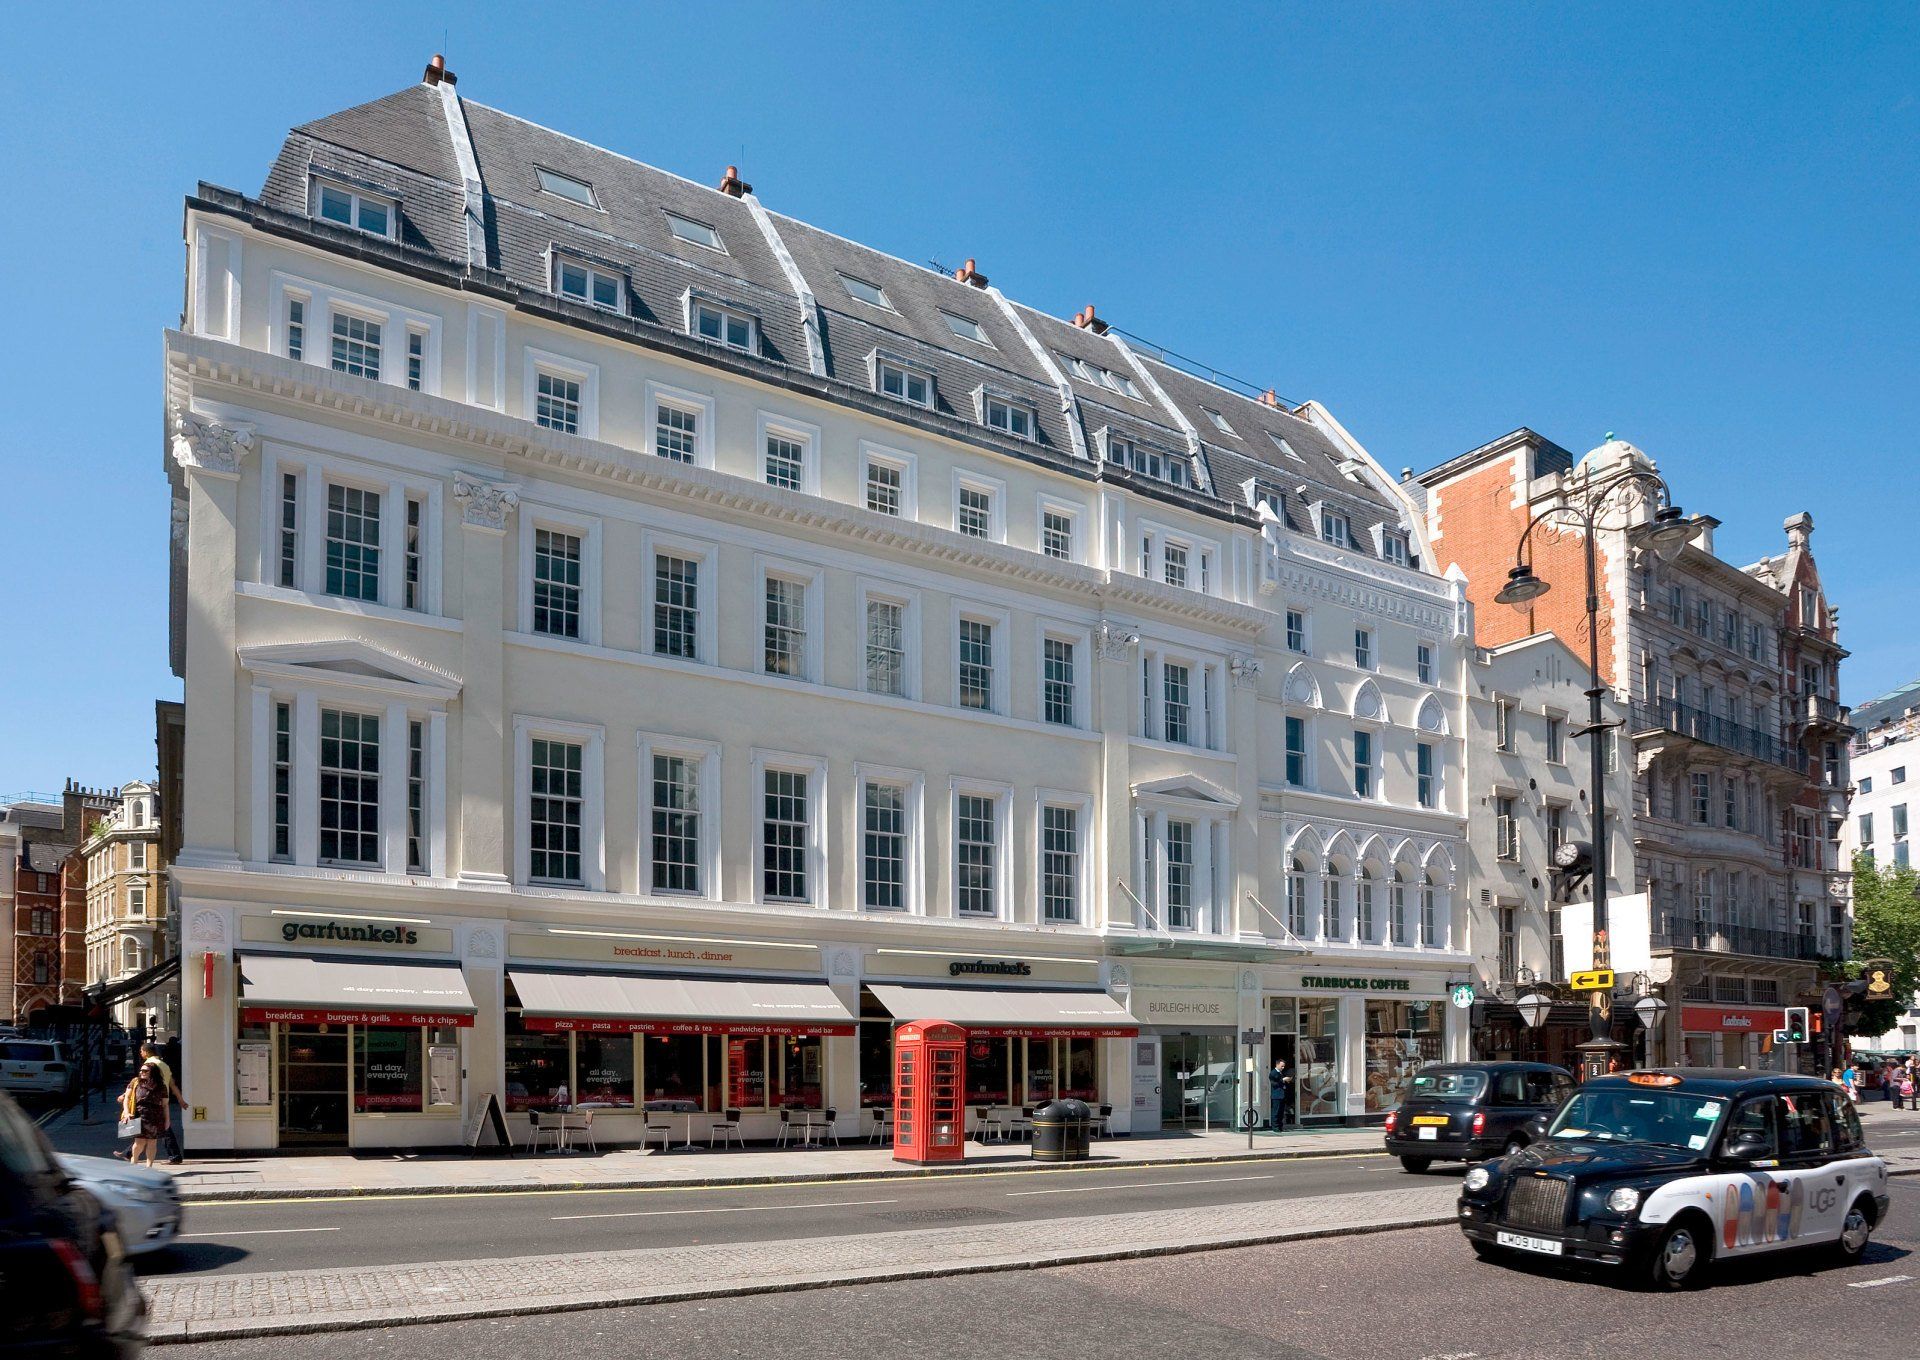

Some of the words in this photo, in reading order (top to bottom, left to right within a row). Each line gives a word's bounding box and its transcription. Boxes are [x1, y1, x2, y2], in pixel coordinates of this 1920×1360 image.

[282, 922, 417, 944] garfunkel's
[613, 946, 662, 958] breakfast
[667, 948, 695, 960] lunch
[701, 951, 732, 961] dinner
[950, 959, 1031, 976] garfunkel's
[1301, 976, 1368, 989] STARBUCKS
[1370, 979, 1409, 990] COFFEE
[1149, 1002, 1190, 1013] BURLEIGH
[1192, 1003, 1220, 1014] HOUSE
[265, 1012, 304, 1020] breakfast
[327, 1013, 359, 1023] burgers
[362, 1014, 368, 1022] &
[371, 1014, 391, 1023] grills
[411, 1015, 425, 1024] fish
[428, 1016, 435, 1024] &
[437, 1016, 458, 1025] chips
[555, 1021, 573, 1029] pizza
[592, 1022, 611, 1030] pasta
[629, 1022, 655, 1031] pastries
[672, 1024, 693, 1032] coffee
[729, 1025, 764, 1033] sandwiches
[384, 1064, 404, 1073] day,
[366, 1072, 409, 1080] everyday
[586, 1076, 622, 1084] everyday
[194, 1107, 205, 1120] H
[1809, 1188, 1836, 1213] UGG
[1532, 1238, 1556, 1252] ULJ
